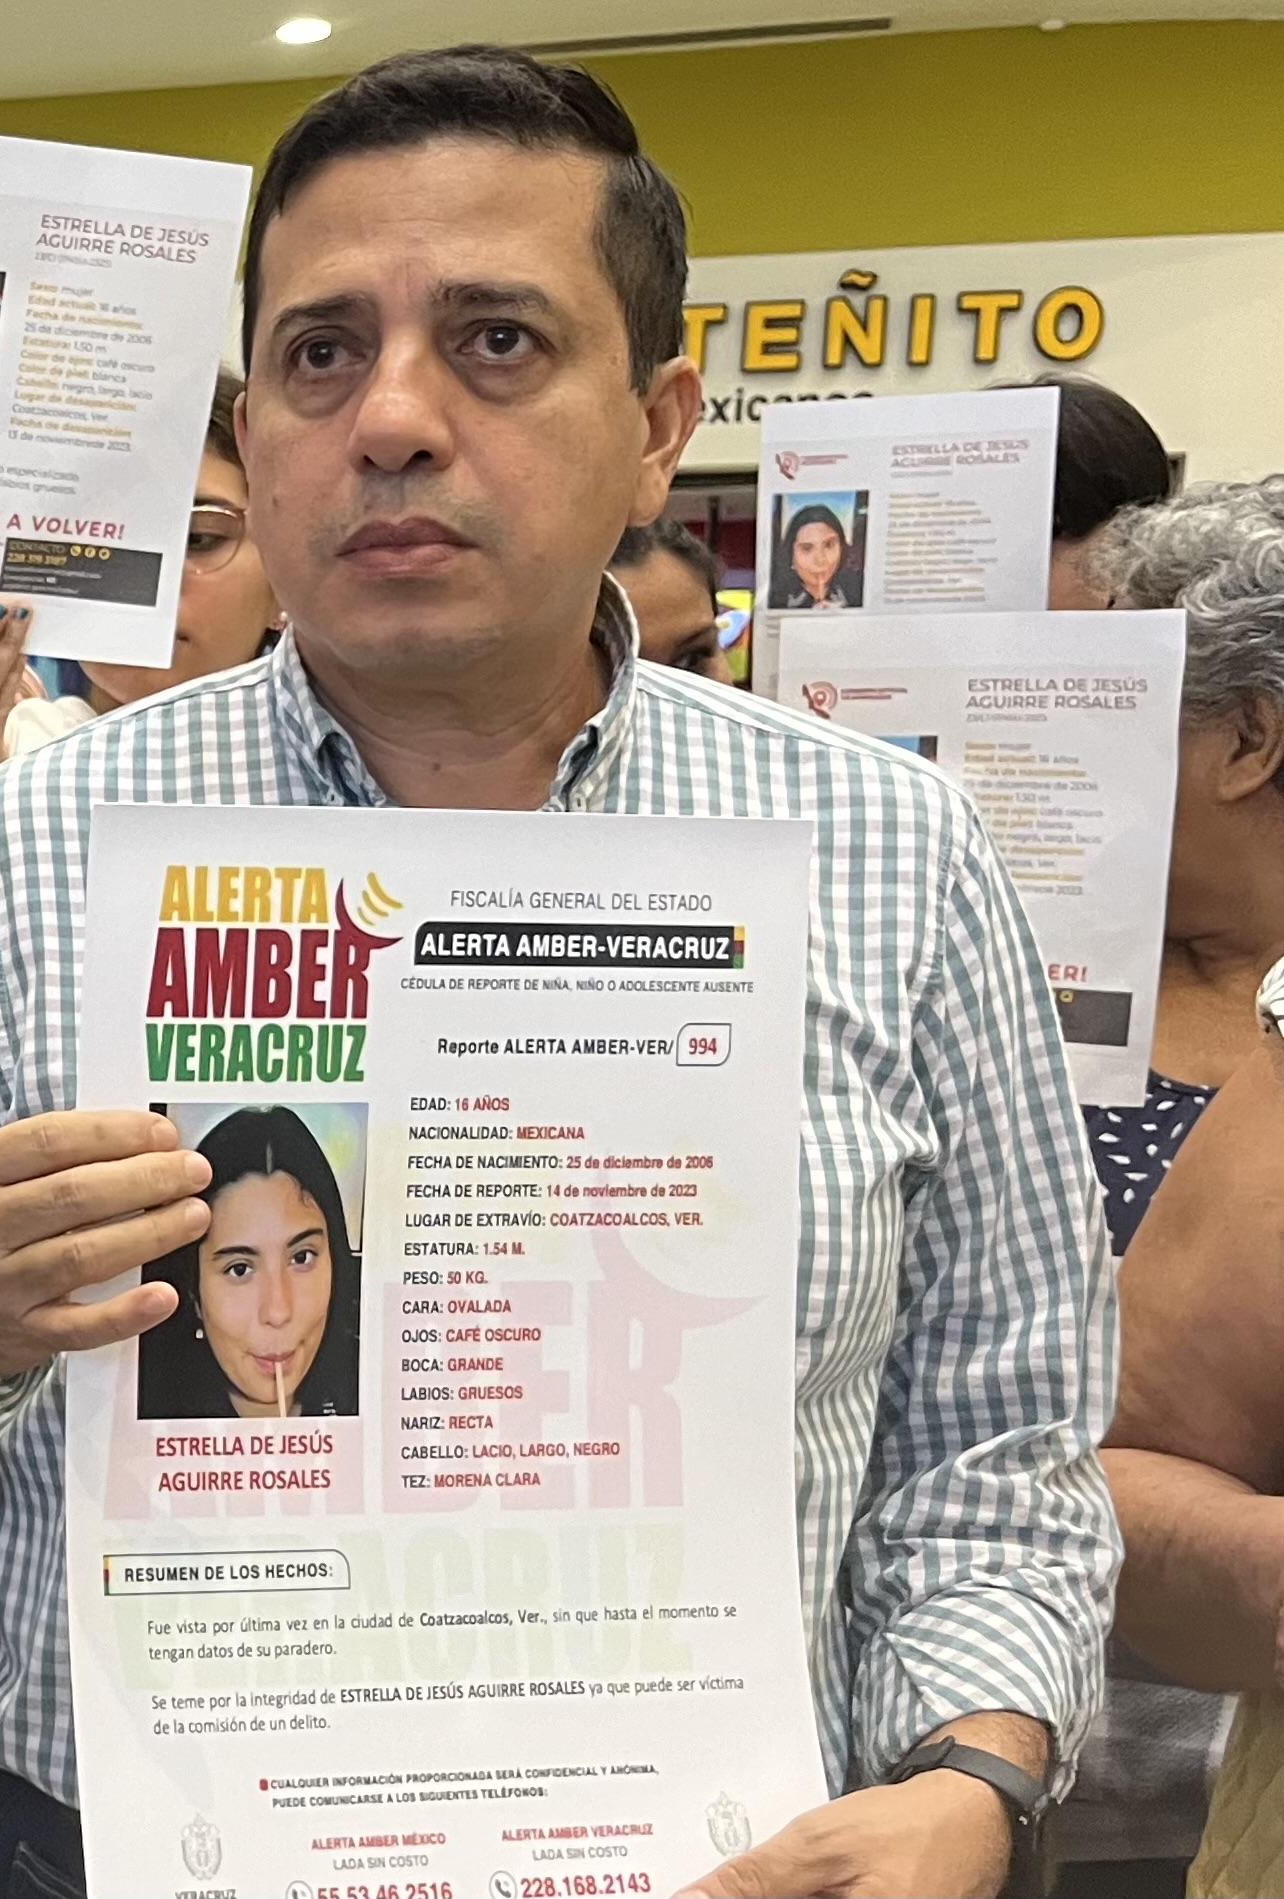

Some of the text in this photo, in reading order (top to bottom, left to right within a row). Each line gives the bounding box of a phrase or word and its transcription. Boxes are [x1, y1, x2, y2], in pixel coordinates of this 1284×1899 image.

[40, 213, 210, 247] ESTRELLA DE JESÚS
[35, 232, 116, 255] AGUIRRE
[119, 241, 197, 265] ROSALES
[6, 513, 22, 531] A
[31, 515, 125, 540] VOLVER!
[967, 677, 1149, 694] ESTRELLA DE JESÚS
[965, 694, 1138, 711] AGUIRRE ROSALES
[159, 865, 330, 924] ALERTA
[450, 888, 712, 912] FISCALÍA GENERAL DEL ESTADO
[420, 933, 730, 960] ALERTA AMBER-VERACRUZ
[146, 926, 371, 1019] AMBER
[400, 976, 754, 994] CÉDULA DE REPORTE DE NIÑA, NIÑO O ADOLESCENTE AUSENTE
[145, 1023, 367, 1083] VERACRUZ
[437, 1037, 718, 1058] Reporte ALERTA AMBER-VER/ 994
[410, 1094, 510, 1112] EDAD: 16 AÑOS
[408, 1126, 585, 1141] NACIONALIDAD: MEXICANA
[407, 1155, 714, 1169] FECHA DE NACIMIENTO: 25 de diciembre de 2006
[405, 1210, 704, 1228] LUGAR DE EXTRAVÍO: COATZACOALCOS, VER.
[404, 1241, 526, 1257] ESTATURA: 1.54 M.
[402, 1270, 489, 1285] PESO: 50 KG.
[402, 1299, 512, 1315] CARA: OVALADA
[401, 1327, 542, 1343] OJOS: CAFÉ OSCURO
[401, 1357, 504, 1372] BOCA: GRANDE
[401, 1385, 524, 1401] LABIOS: GRUESOS
[401, 1415, 494, 1431] NARIZ: RECTA
[156, 1430, 333, 1457] ESTRELLA DE JESÚS
[401, 1442, 621, 1460] CABELLO: LACIO, LARGO, NEGRO
[158, 1469, 331, 1492] AGUIRRE ROSALES
[401, 1472, 541, 1489] TEZ: MORENA CLARA
[124, 1562, 333, 1583] RESUMEN DE LOS HECHOS:
[153, 1714, 331, 1736] de la comisión de un delito.
[520, 1872, 652, 1899] 228.168.2143
